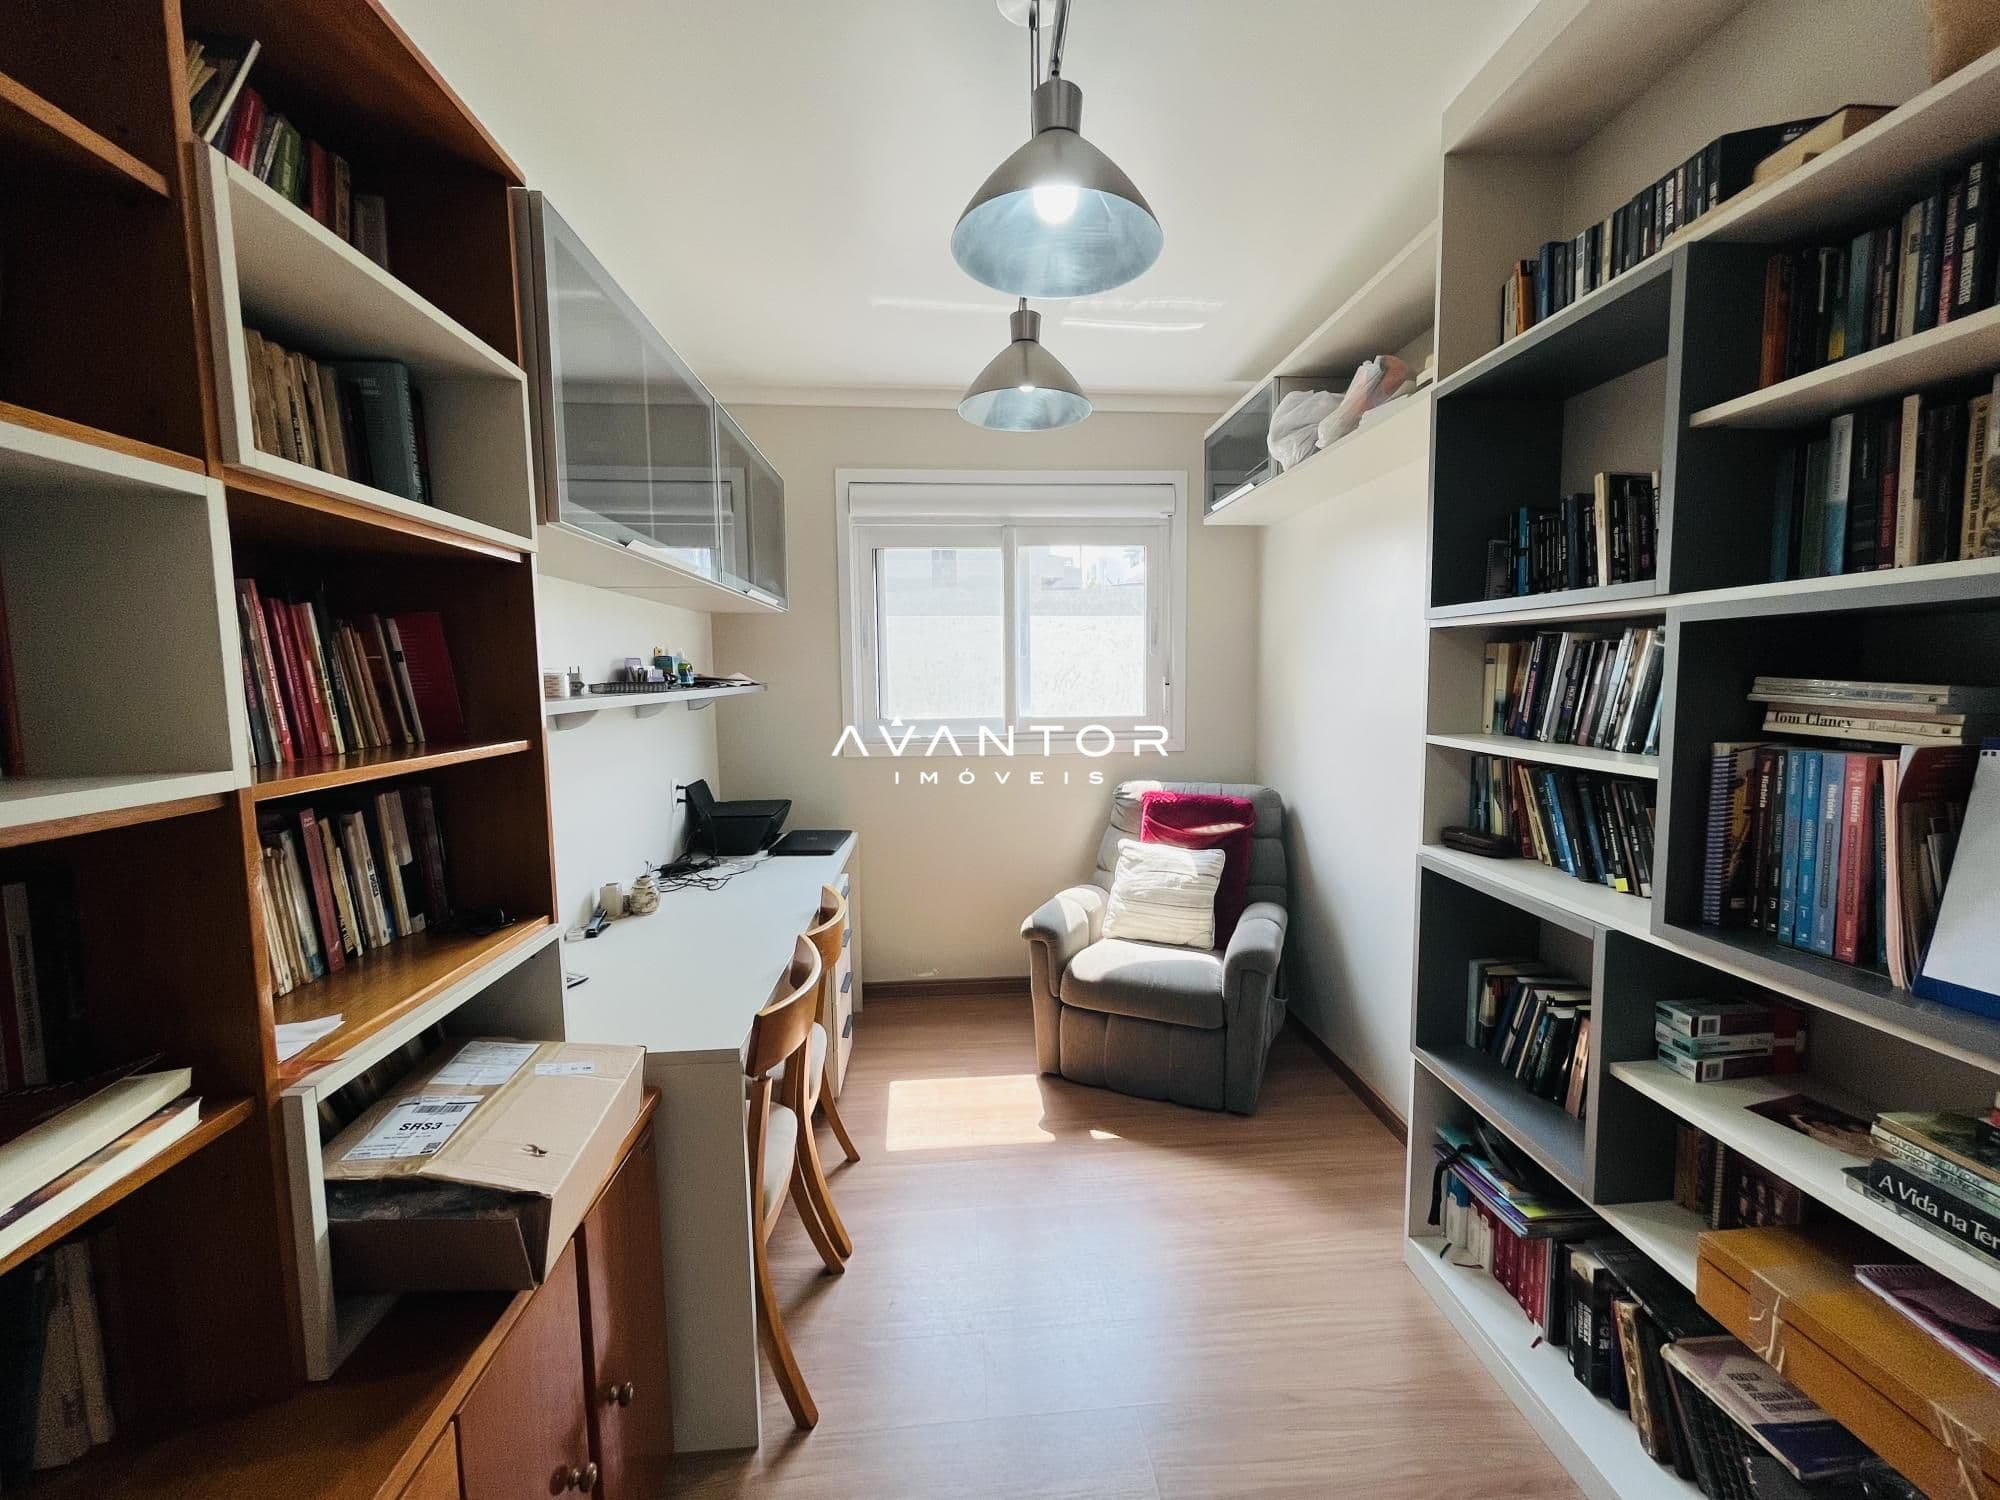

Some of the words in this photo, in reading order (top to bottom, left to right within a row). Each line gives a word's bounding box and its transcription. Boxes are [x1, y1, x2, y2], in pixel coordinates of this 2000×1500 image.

[1773, 711, 1800, 725] Tom
[1805, 712, 1854, 729] Clancy
[1759, 775, 1770, 808] História
[1850, 786, 1863, 823] História
[399, 1121, 443, 1132] SRS3
[1878, 1175, 1895, 1194] A
[1898, 1180, 1939, 1218] Vida
[1943, 1210, 1968, 1233] na
